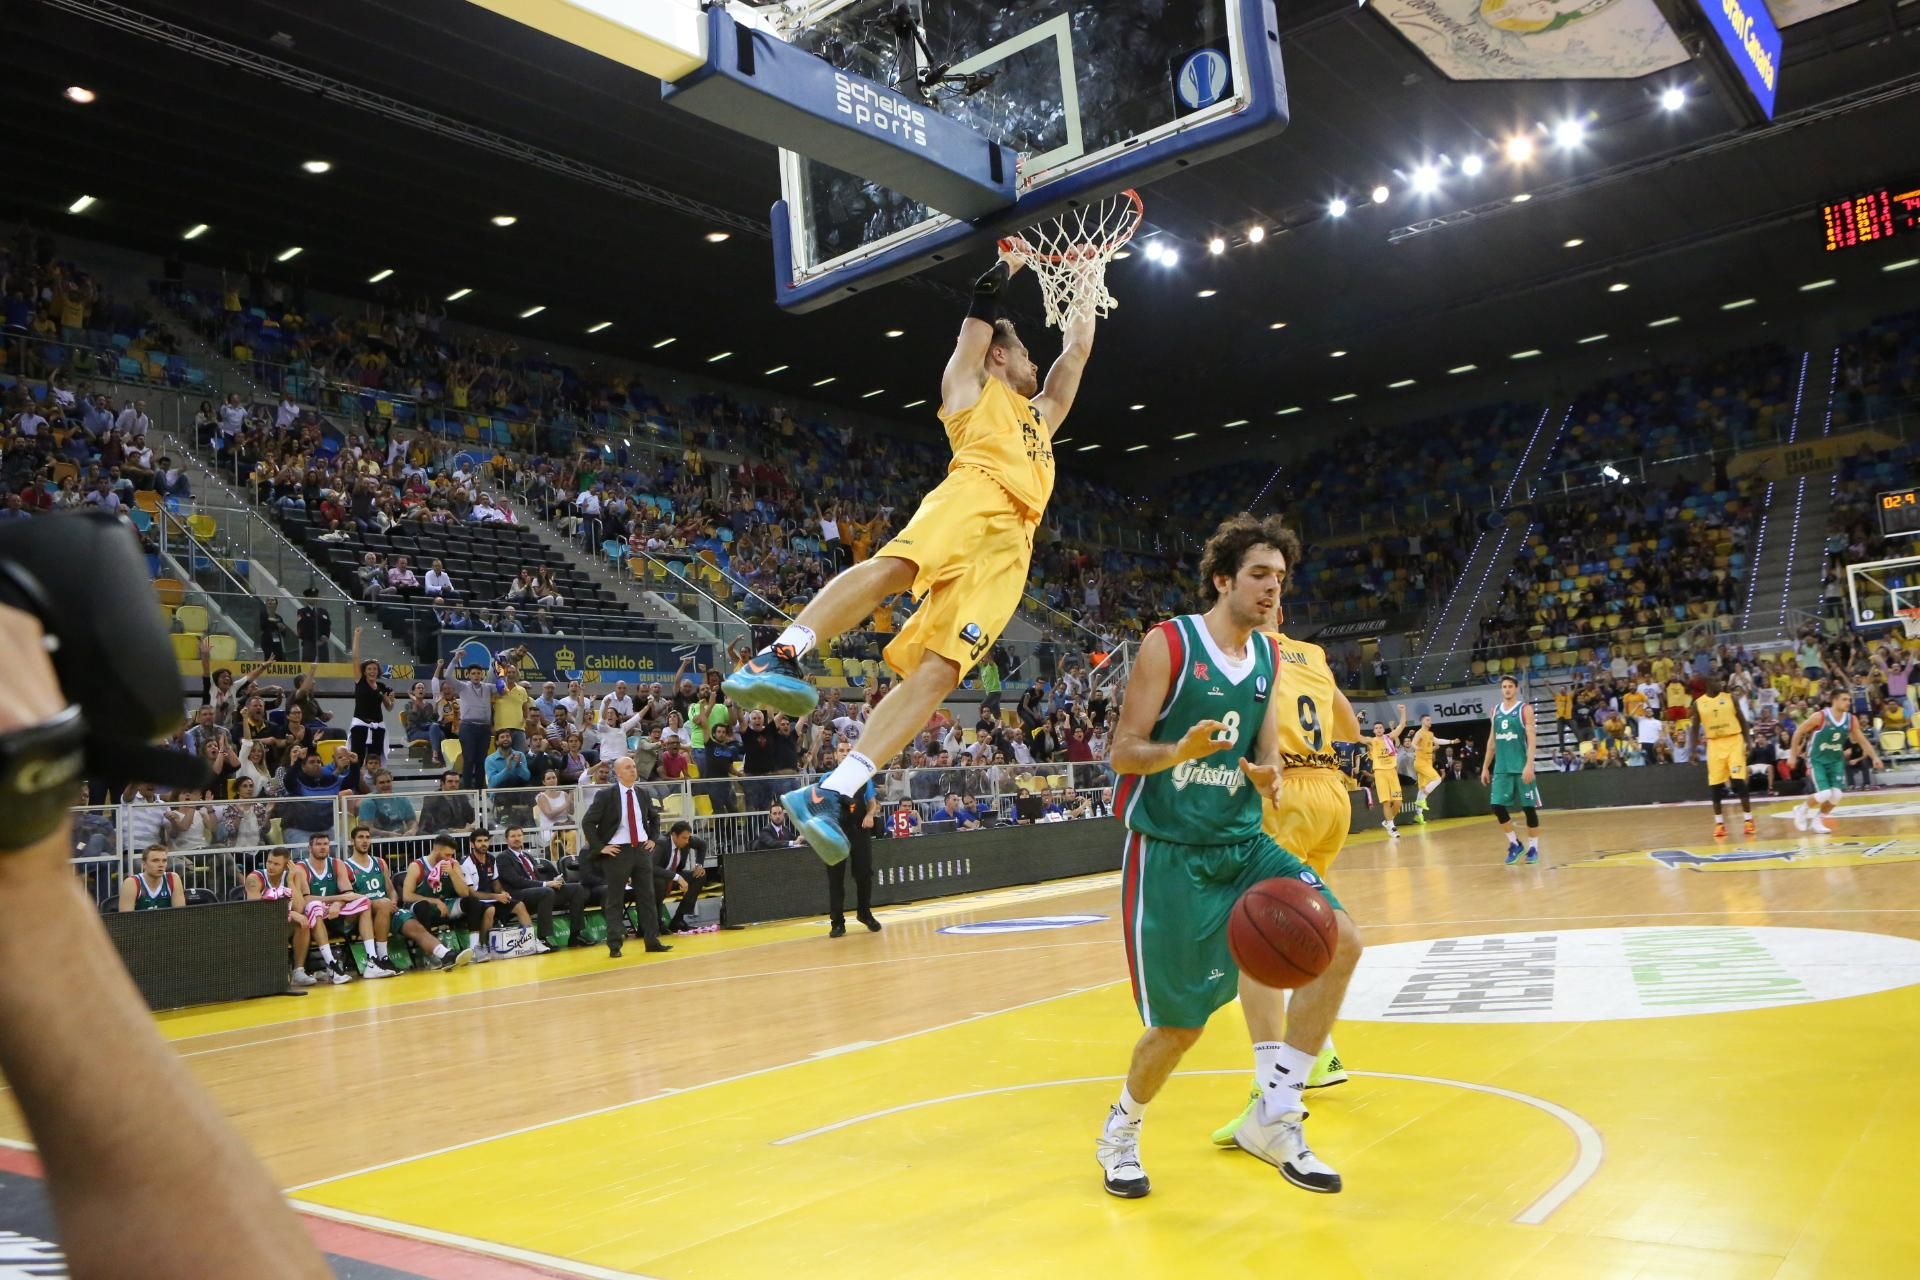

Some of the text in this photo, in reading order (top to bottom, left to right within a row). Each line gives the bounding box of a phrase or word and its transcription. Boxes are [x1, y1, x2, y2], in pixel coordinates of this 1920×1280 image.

[1744, 16, 1774, 91] Canaria
[834, 72, 925, 128] Schelde
[837, 92, 927, 146] Sports
[241, 663, 302, 674] GRA CANARIA
[585, 655, 654, 669] Cabildo de
[1218, 710, 1240, 748] 8
[1298, 695, 1323, 751] 9
[1501, 719, 1508, 729] 6
[898, 813, 908, 829] 5
[320, 886, 327, 897] 7
[366, 878, 380, 891] 10
[1382, 935, 1558, 1017] HERBALIFE
